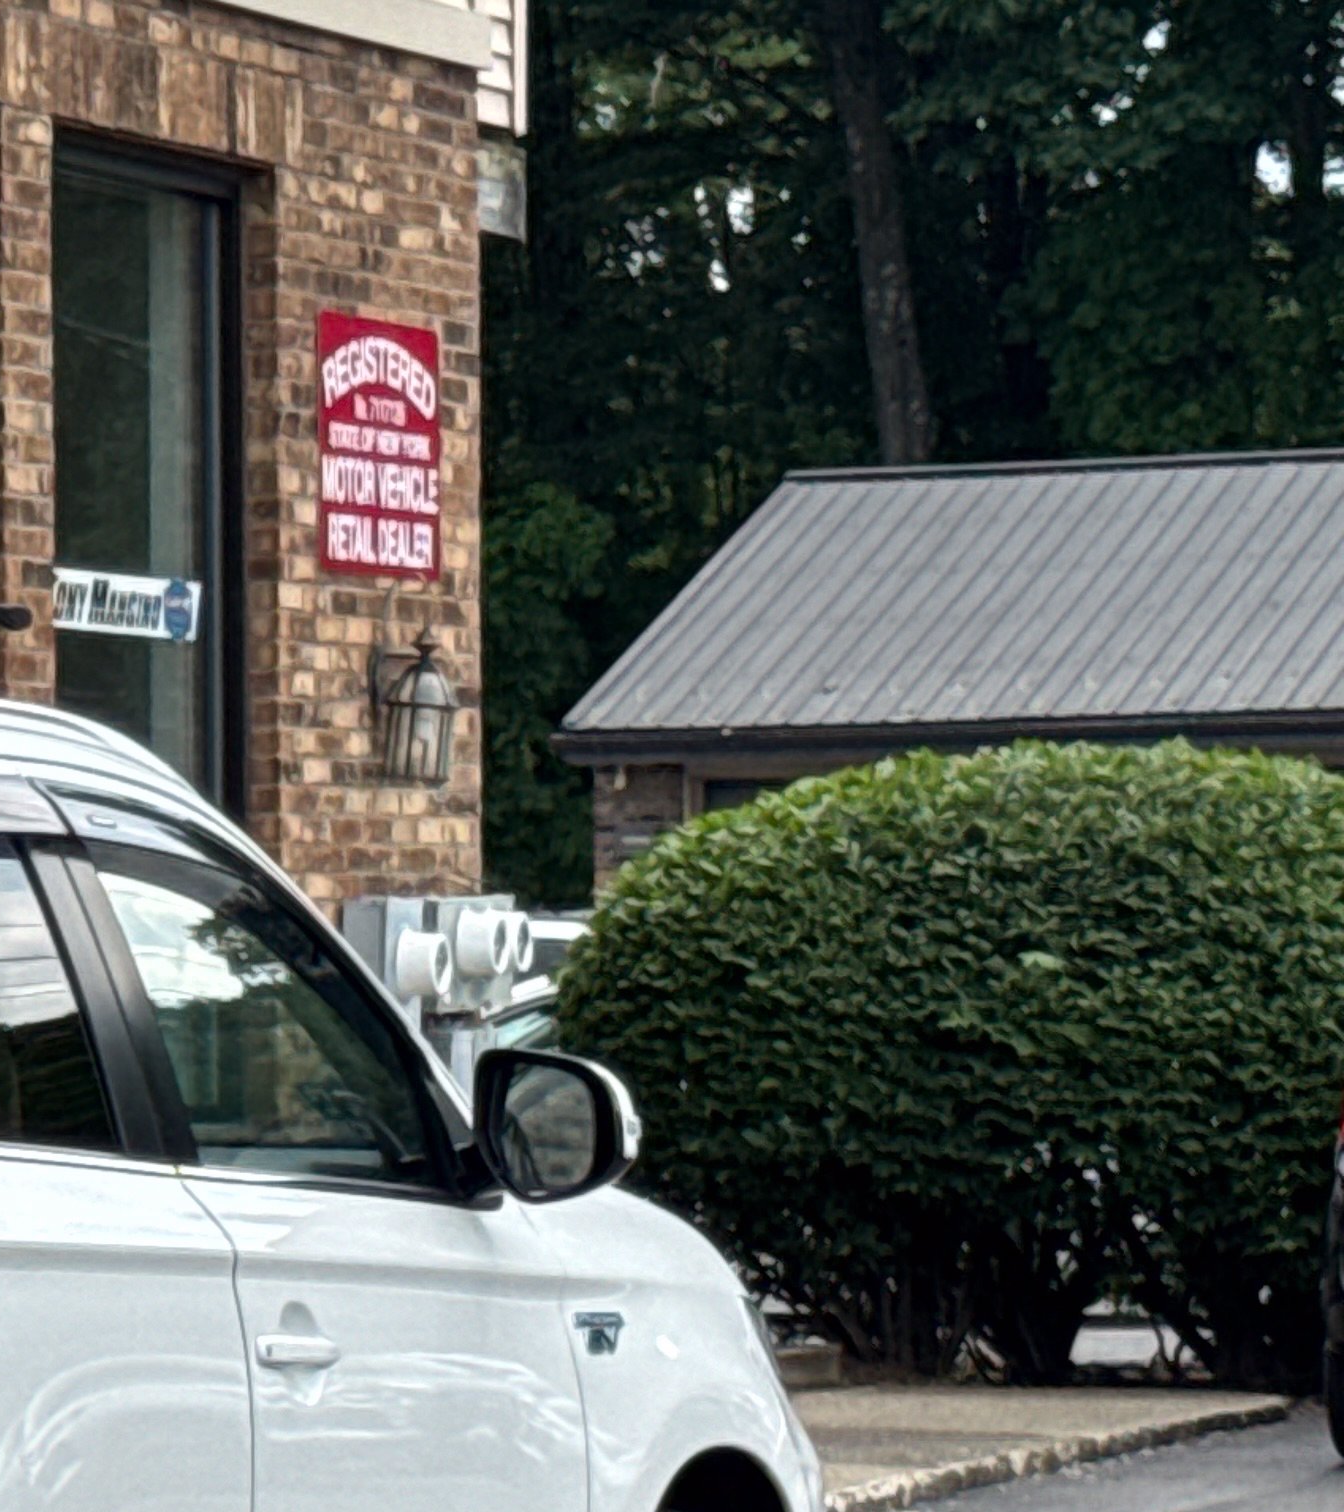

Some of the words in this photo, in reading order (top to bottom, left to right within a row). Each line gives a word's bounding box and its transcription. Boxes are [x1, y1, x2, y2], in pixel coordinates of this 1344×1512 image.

[321, 335, 437, 421] REGISTERED
[321, 454, 376, 507] MOTOR
[377, 462, 439, 516] VEHICLE
[327, 512, 377, 565] RETAIL
[378, 518, 433, 569] DEALER
[53, 581, 89, 623] ONY
